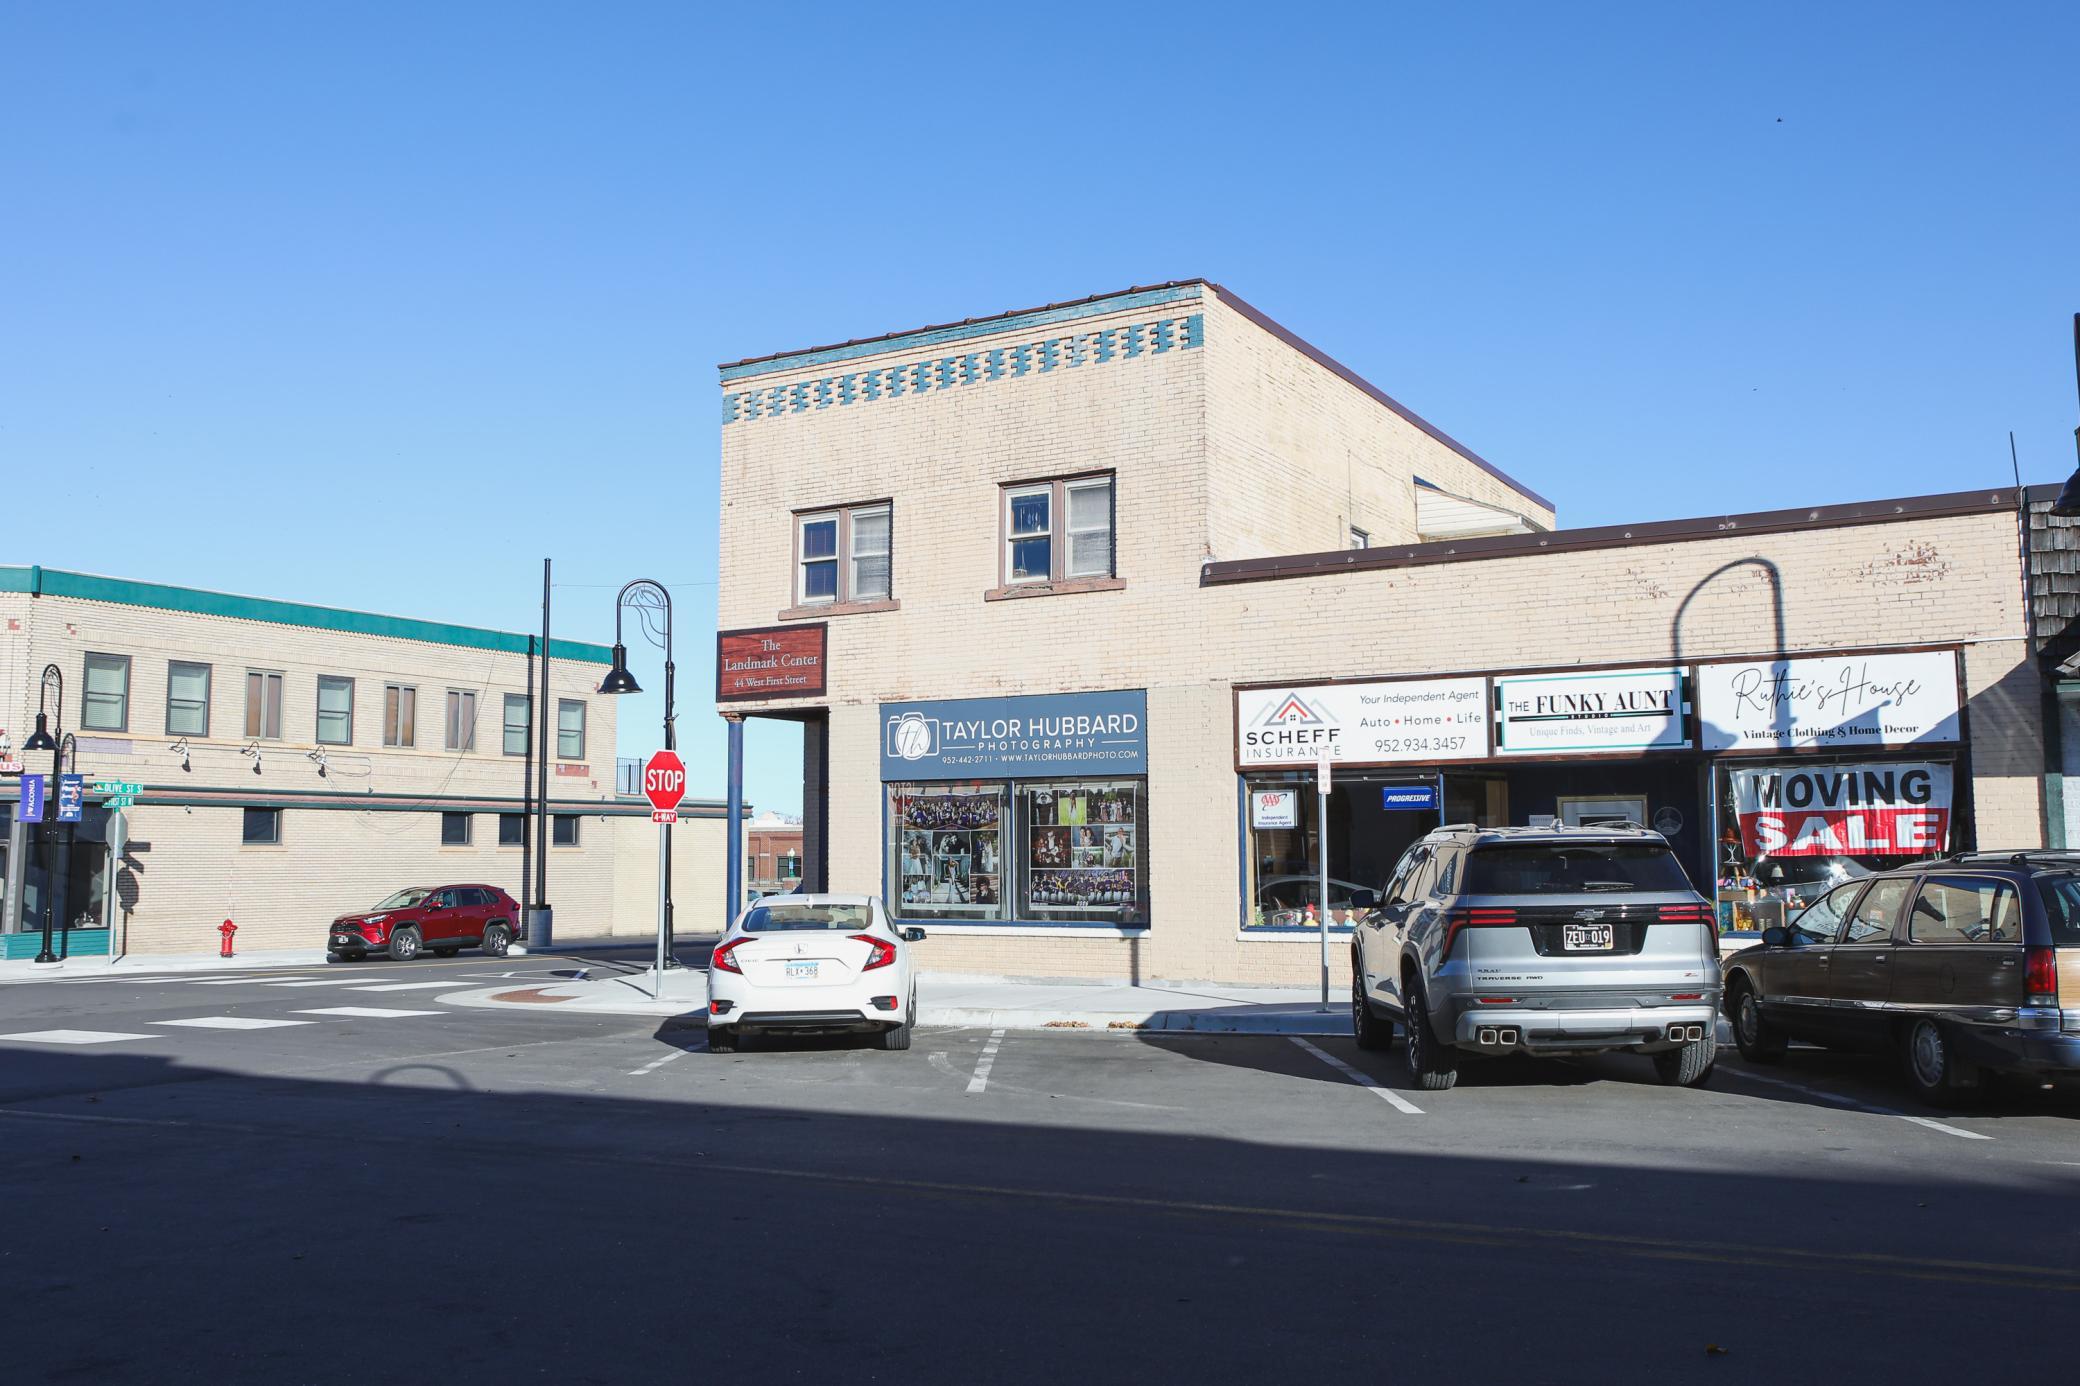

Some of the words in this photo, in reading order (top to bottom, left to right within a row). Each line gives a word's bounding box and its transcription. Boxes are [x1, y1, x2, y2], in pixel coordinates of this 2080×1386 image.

[761, 639, 781, 652] The
[725, 654, 778, 672] Landmark
[781, 653, 818, 667] Center
[734, 678, 744, 688] 44
[745, 677, 764, 687] West
[766, 676, 783, 685] First
[785, 675, 807, 684] Street
[1828, 662, 1921, 716] House
[1360, 694, 1381, 705] Your
[1383, 691, 1446, 705] Independent
[1448, 690, 1480, 702] Agent
[1509, 701, 1529, 712] THE
[1536, 692, 1607, 714] FUNKY
[1614, 689, 1674, 710] AUNT
[942, 719, 1021, 740] TAYLOR
[1029, 714, 1138, 737] HUBBARD
[1360, 717, 1391, 728] Auto
[1404, 715, 1441, 726] Home
[1457, 713, 1481, 724] Life
[1246, 728, 1341, 745] SCHEFF
[1529, 725, 1558, 738] Unique
[1560, 725, 1585, 737] Finds,
[1587, 724, 1618, 737] Vintage
[1620, 723, 1636, 734] and
[1638, 723, 1651, 733] Art
[1743, 727, 1785, 740] Vintage
[1787, 726, 1835, 741] Clothing
[1837, 727, 1847, 738] &
[1849, 725, 1881, 736] Home
[1884, 724, 1919, 734] Decor
[978, 738, 1095, 751] PHOTOGRAPHY
[1246, 745, 1342, 759] INSURANE
[1375, 736, 1466, 753] 952.934.3457
[942, 756, 992, 764] 952-442-2711
[1001, 751, 1139, 762] WWW.TAYLORHUBBARDPHOTO.COM
[105, 783, 122, 793] OLIVE
[126, 784, 134, 793] ST
[647, 769, 684, 792] STOP
[1753, 769, 1931, 808] MOVING
[1262, 794, 1280, 806] AAA
[1386, 794, 1431, 803] PROGRESSIVE
[653, 812, 676, 823] 4-WAY
[1755, 813, 1938, 851] SALE
[1566, 930, 1586, 944] ZEU
[1591, 930, 1610, 943] 019
